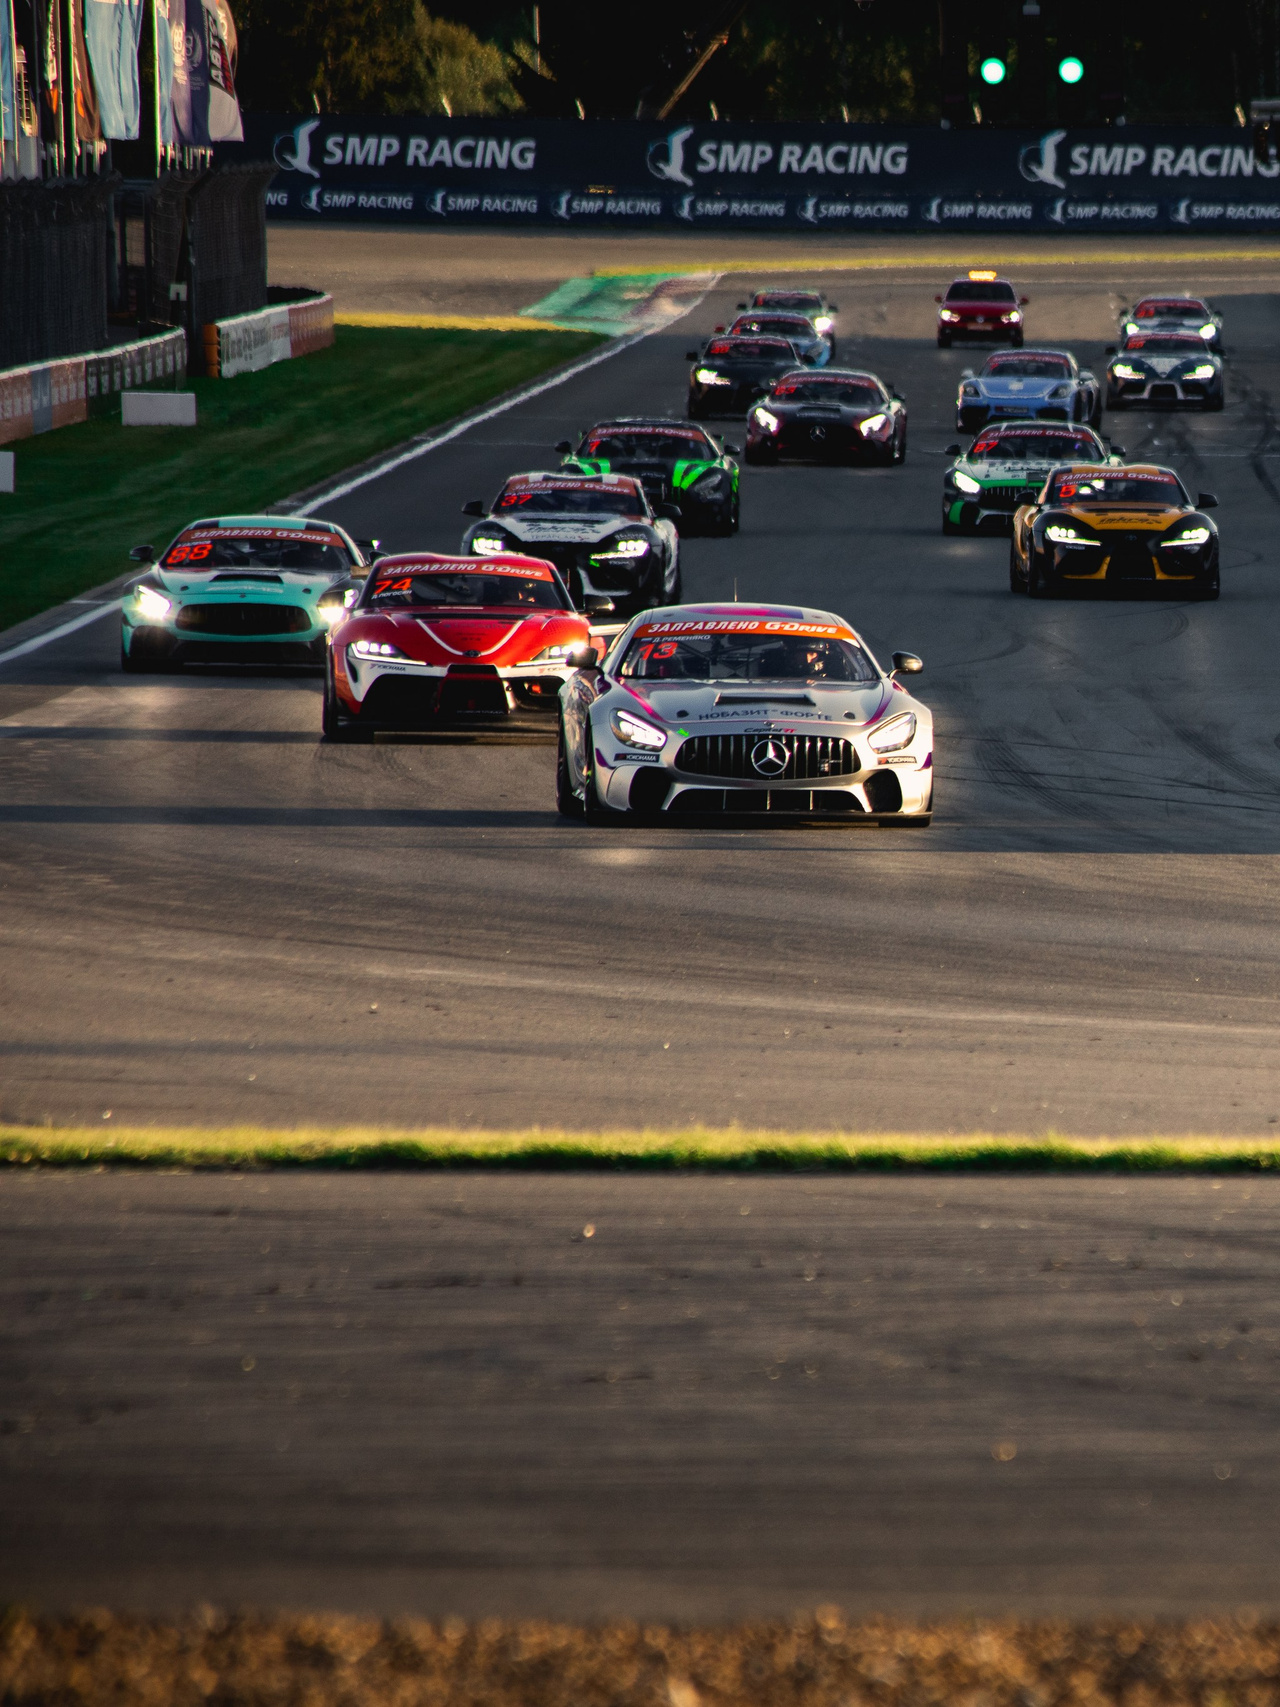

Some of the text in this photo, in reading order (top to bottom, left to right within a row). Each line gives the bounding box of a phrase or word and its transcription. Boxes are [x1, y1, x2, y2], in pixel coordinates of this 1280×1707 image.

[322, 134, 537, 171] SMP RACING
[695, 141, 909, 175] SMP RACING
[1068, 145, 1147, 177] SMP
[322, 192, 414, 211] SMP RACING
[447, 195, 538, 214] SMP RACING
[571, 199, 661, 216] SMP RACING
[695, 200, 787, 218] SMP RACING
[818, 201, 909, 219] SMP RACING
[942, 203, 1032, 220] SMP RACING
[1066, 203, 1158, 221] SMP RACING
[1191, 203, 1224, 220] SMP
[1059, 484, 1078, 498] 5
[500, 494, 533, 507] 37
[166, 543, 214, 564] 88
[383, 563, 478, 576] ЗАПРАВЛЕНО
[373, 577, 413, 595] 74
[647, 621, 760, 633] ЗАПРАВЛЕНО
[638, 641, 678, 661] 13
[780, 710, 833, 721] ФОРТЕ
[626, 754, 657, 762] YOKOHAMA
